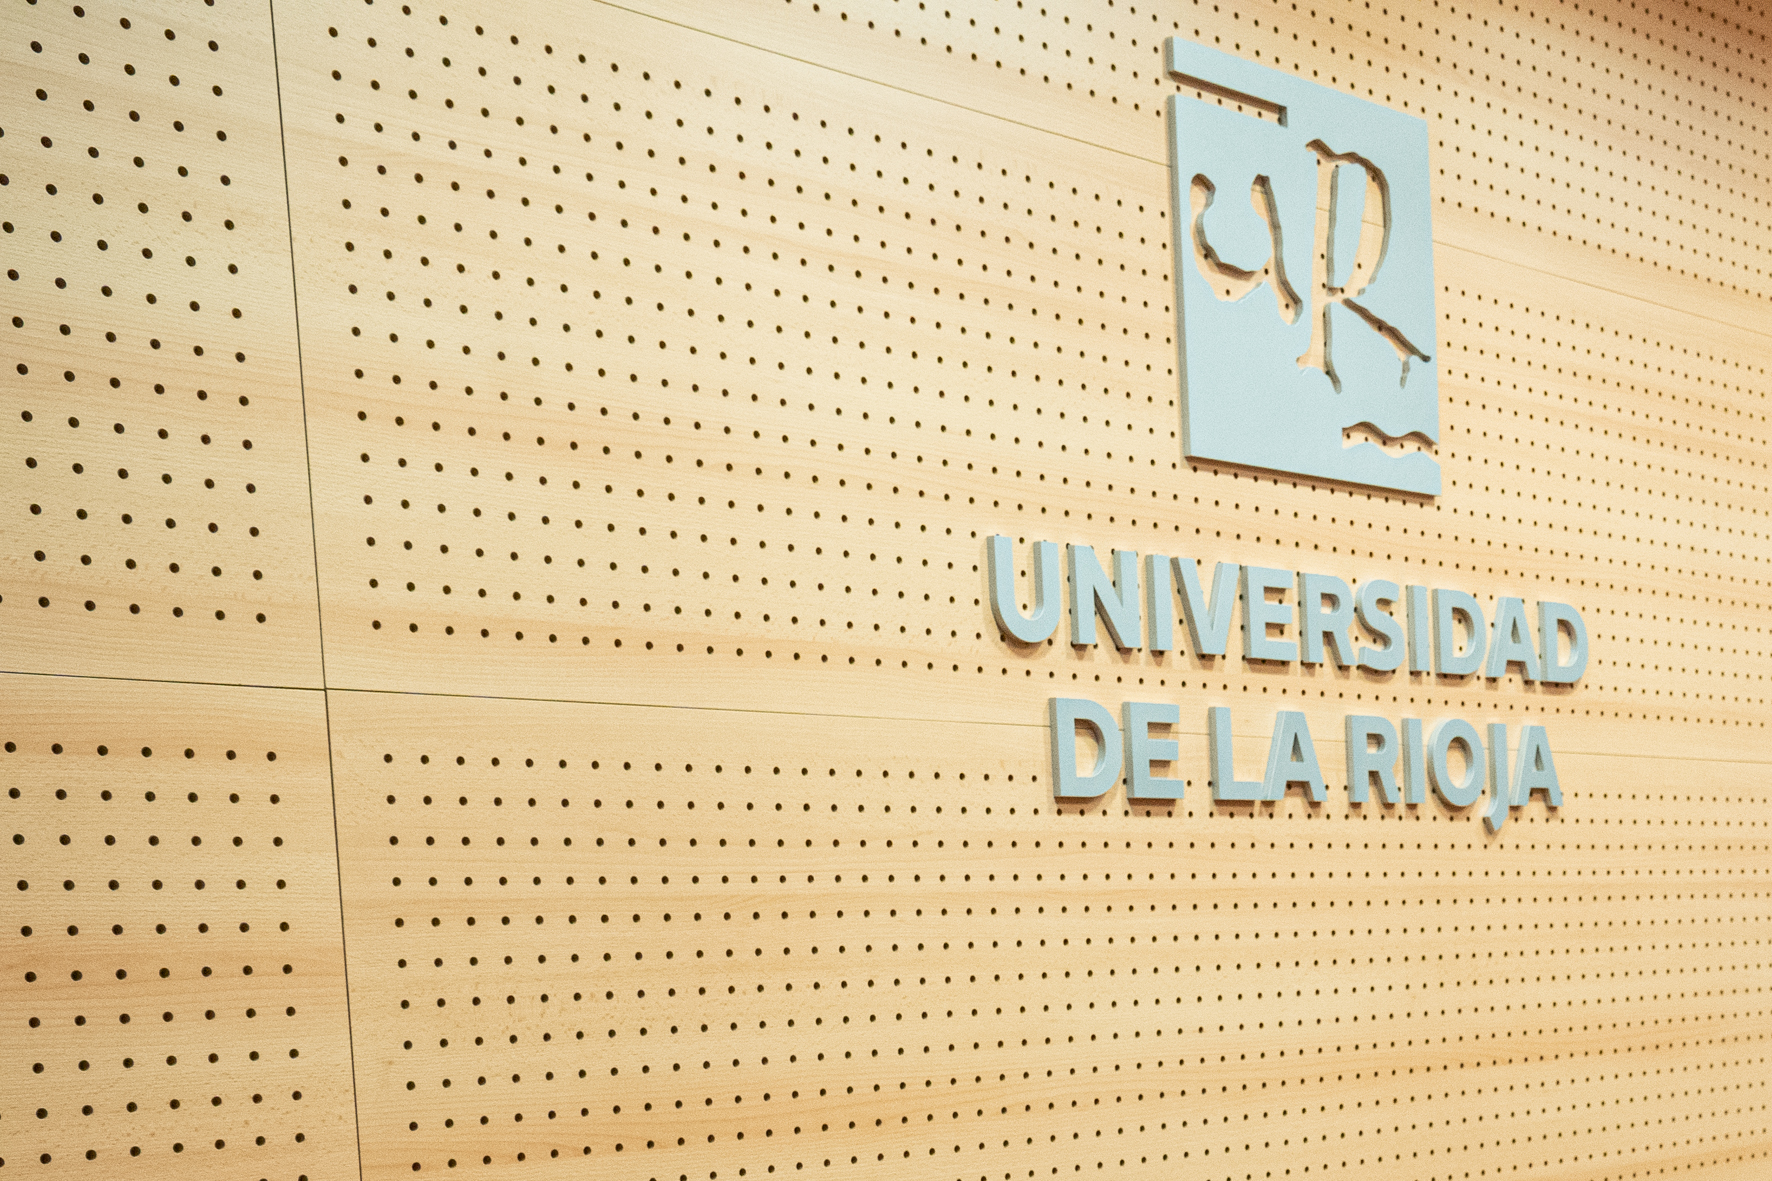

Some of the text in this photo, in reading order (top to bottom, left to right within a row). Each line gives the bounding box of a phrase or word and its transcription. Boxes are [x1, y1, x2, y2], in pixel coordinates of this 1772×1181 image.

[986, 534, 1590, 685] UNIVERSIDAD
[1049, 696, 1564, 836] DE LA RIOJA
